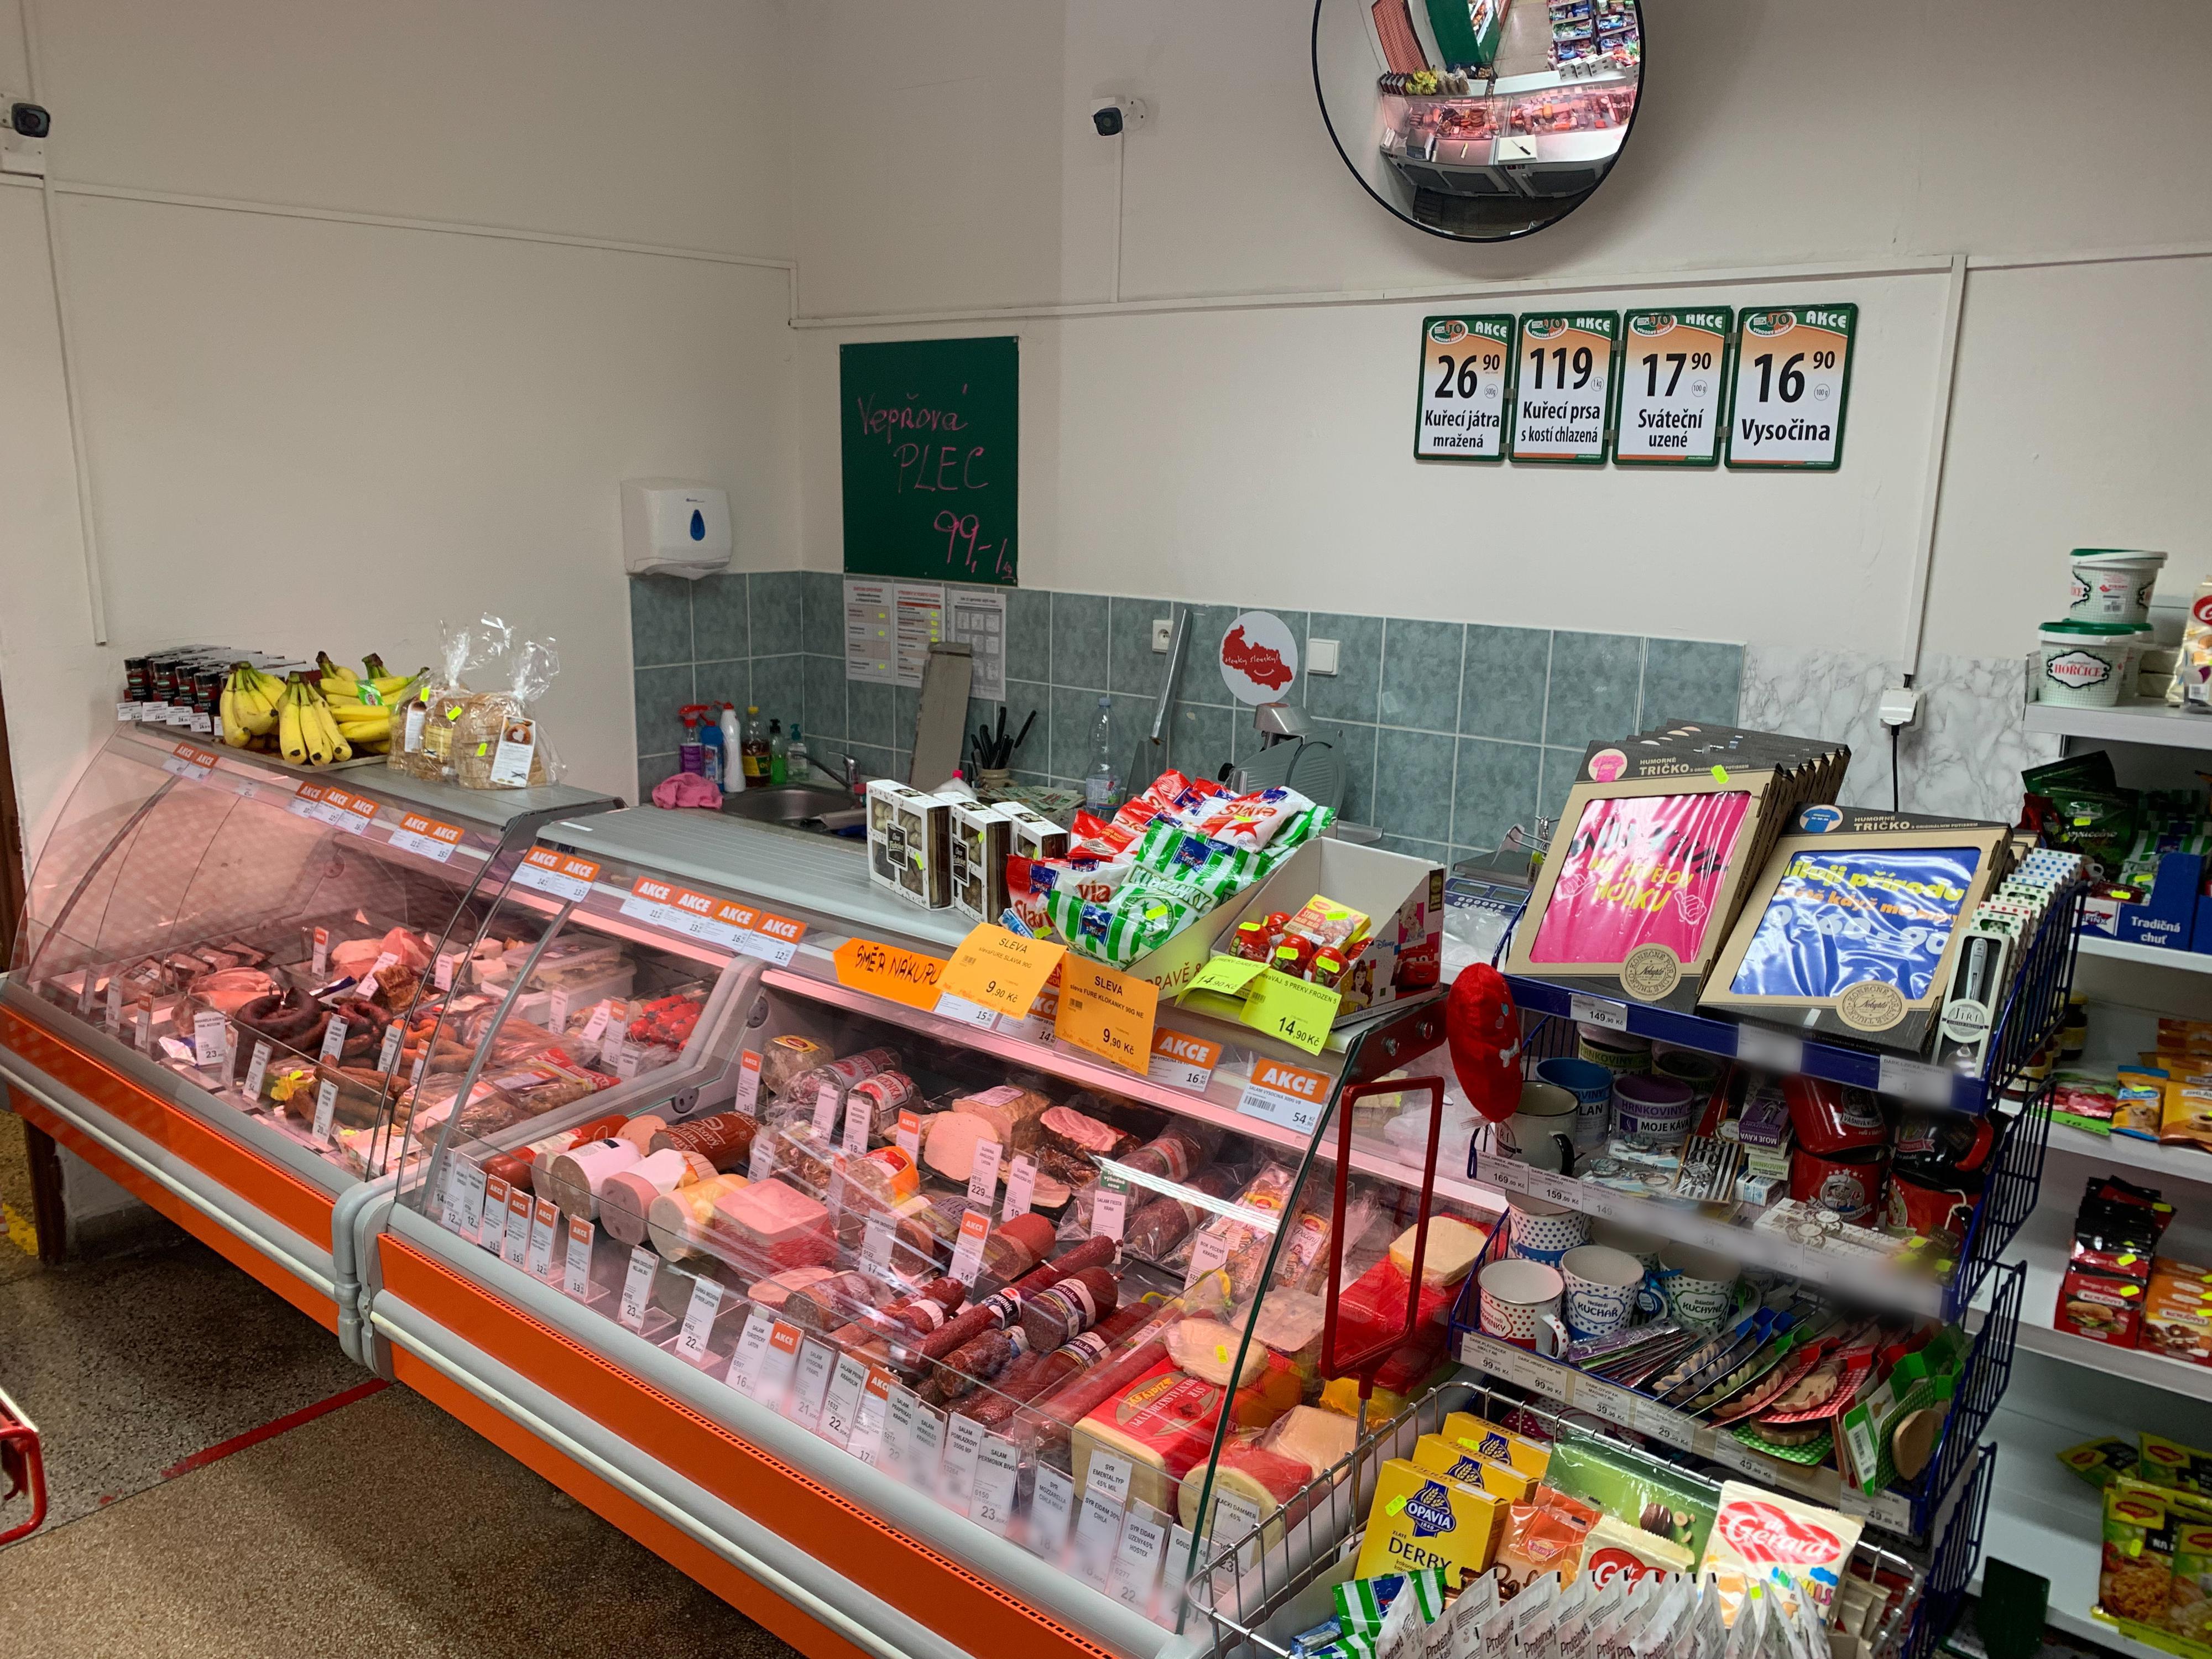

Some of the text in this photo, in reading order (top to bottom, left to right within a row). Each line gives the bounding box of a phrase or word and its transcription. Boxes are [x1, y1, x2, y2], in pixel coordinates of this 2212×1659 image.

[1576, 317, 1610, 332] AKCE
[1686, 314, 1723, 328] AKCE
[1806, 311, 1846, 328] AKCE
[1475, 321, 1507, 338] AKCE
[1530, 347, 1593, 389] 119
[1642, 352, 1712, 397] 17 90
[1434, 354, 1500, 399] 26 90
[1754, 351, 1835, 403] 16 90
[1523, 401, 1601, 424] Kuřecí prsa
[1638, 408, 1705, 429] Sváteční
[1425, 410, 1500, 431] Kuřecí játra
[1521, 426, 1598, 443] s kostí chlazená
[1649, 431, 1688, 448] uzené
[1741, 419, 1830, 446] Vysočina
[1433, 434, 1483, 448] mražená
[2054, 664, 2101, 677] HOŘČICE
[1640, 757, 1676, 765] HUMORNÉ
[1639, 763, 1689, 776] TRIČKO
[300, 785, 321, 799] AKCE
[327, 791, 348, 806] AKCE
[352, 799, 374, 815] AKCE
[405, 816, 429, 832] AKCE
[1854, 819, 1911, 832] TRIČKO
[432, 826, 458, 842] AKCE
[529, 851, 558, 867] AKCE
[565, 861, 593, 878] AKCE
[639, 882, 670, 900] AKCE
[677, 894, 711, 913] AKCE
[718, 906, 753, 925] AKCE
[762, 919, 798, 938] AKCE
[1376, 940, 1395, 950] Disney
[2141, 931, 2167, 945] chuť
[999, 938, 1028, 954] SLEVA
[888, 952, 941, 986] NÁKUPU
[1094, 975, 1123, 996] SLEVA
[1006, 993, 1019, 1003] Kč
[1083, 988, 1098, 999] FURE
[1098, 995, 1125, 1010] KLOKANKY
[1125, 1006, 1135, 1015] 90G
[1136, 1010, 1144, 1019] NE
[976, 1010, 987, 1020] 15
[1039, 1031, 1050, 1041] 14
[1307, 1036, 1320, 1047] Kč
[206, 1050, 217, 1058] 23
[1124, 1042, 1134, 1055] Kč
[1159, 1036, 1209, 1063] AKCE
[1580, 1047, 1631, 1066] HRNKOVINY
[1186, 1073, 1199, 1083] 16
[1262, 1068, 1318, 1095] AKCE
[1621, 1100, 1684, 1116] HRNKOVINY
[1292, 1112, 1307, 1124] 54
[1640, 1115, 1689, 1132] MOJE KÁVA
[971, 1184, 985, 1197] 229
[512, 1200, 526, 1211] AKCE
[538, 1209, 552, 1221] AKCE
[572, 1227, 587, 1238] AKCE
[965, 1220, 983, 1232] AKCE
[1293, 1227, 1321, 1246] Pečený
[867, 1262, 877, 1273] 17
[627, 1305, 636, 1317] 23
[1577, 1302, 1618, 1318] KUCHAŘ
[752, 1325, 765, 1334] SALAM
[686, 1336, 696, 1349] 22
[774, 1331, 794, 1345] AKCE
[840, 1363, 852, 1374] SALAM
[737, 1374, 747, 1387] 16
[798, 1401, 810, 1415] 21
[897, 1397, 910, 1408] SALAM
[829, 1416, 841, 1431] 22
[921, 1420, 935, 1431] SALAM
[958, 1426, 973, 1436] SALAM
[978, 1454, 1003, 1468] PERMONIK
[990, 1449, 1007, 1459] SALAM
[1104, 1464, 1115, 1472] SYR
[1050, 1481, 1058, 1491] SYR
[1096, 1479, 1107, 1489] 45%
[980, 1505, 995, 1521] 23
[1085, 1497, 1094, 1507] SYR
[1095, 1500, 1110, 1516] EIDAM
[1407, 1502, 1451, 1530] OPAVIA
[1129, 1524, 1155, 1541] SYR EIDAM
[1388, 1537, 1452, 1569] DERBY
[1120, 1586, 1136, 1604] 22
